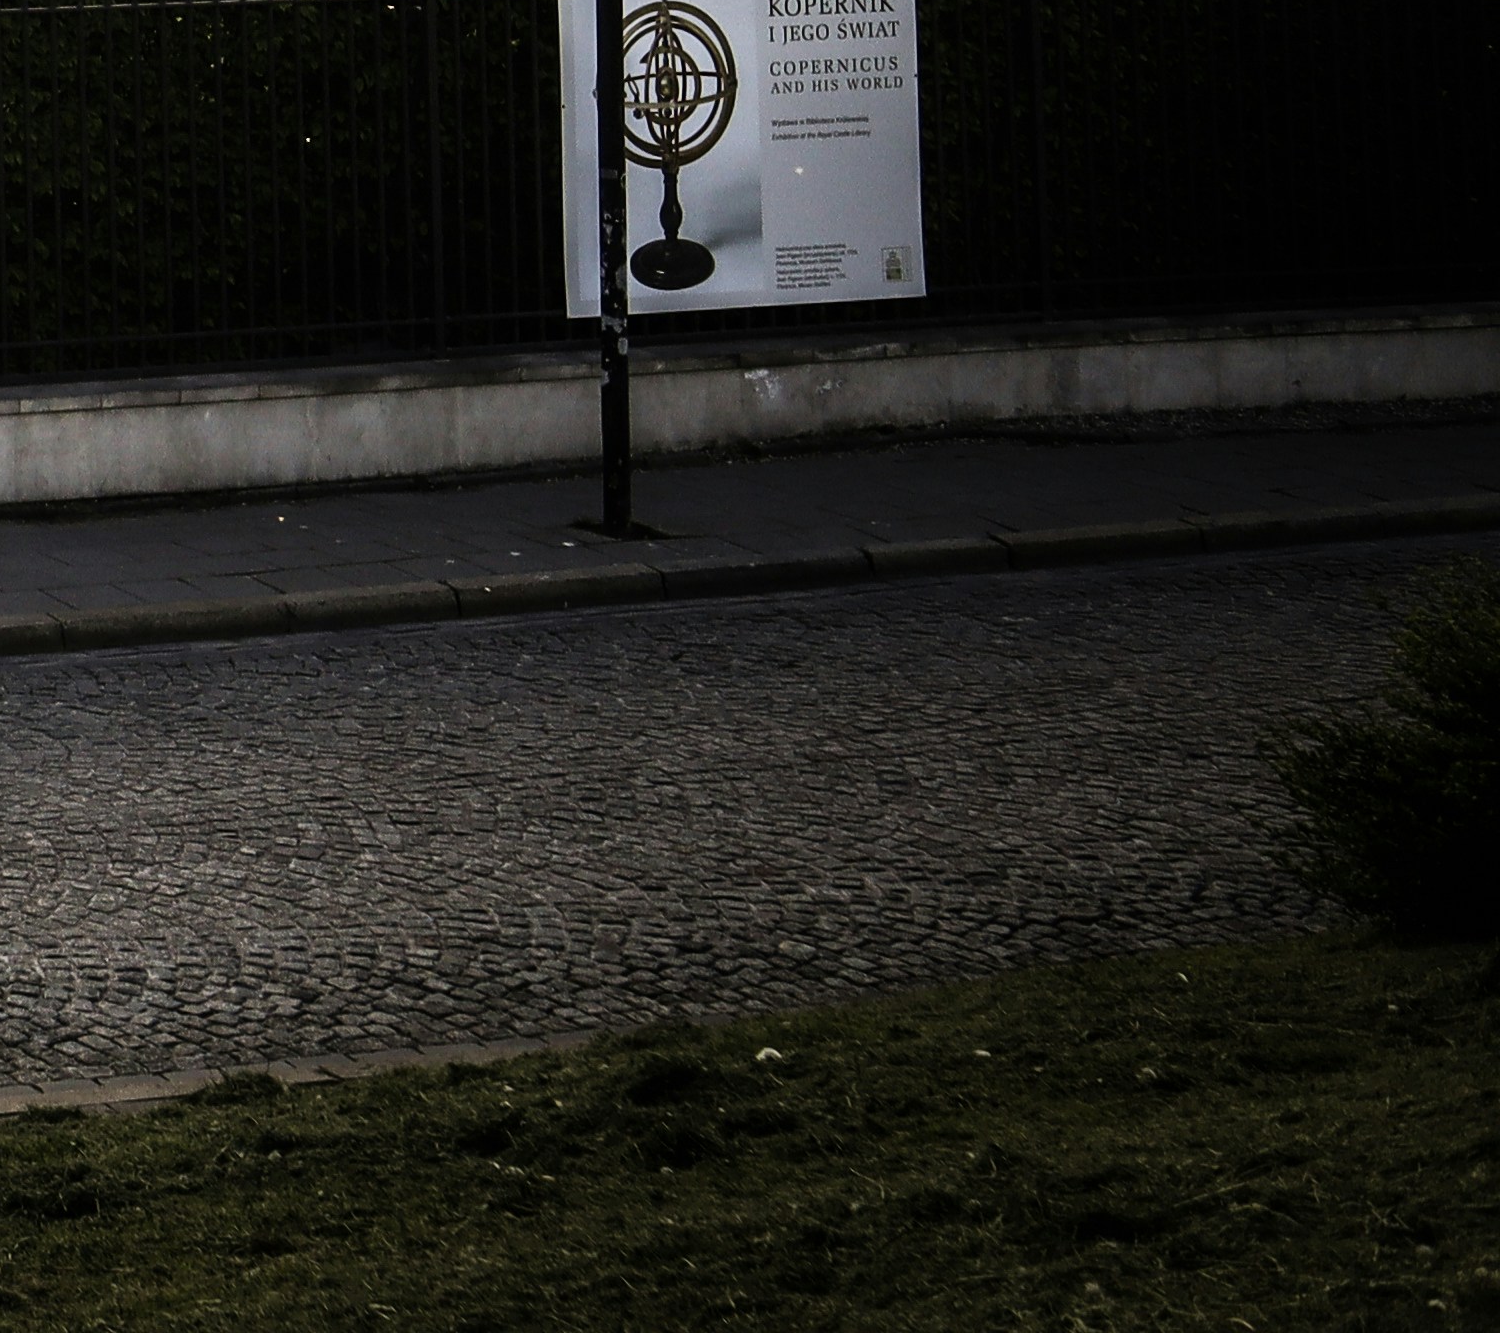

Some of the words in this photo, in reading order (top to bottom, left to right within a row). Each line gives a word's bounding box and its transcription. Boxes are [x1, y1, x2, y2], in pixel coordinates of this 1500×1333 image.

[769, 25, 775, 43] I
[782, 23, 830, 46] JEGO
[837, 18, 900, 40] ŚWIAT
[769, 56, 899, 77] COPERNICUS
[771, 81, 804, 95] AND
[812, 79, 839, 92] HIS
[847, 76, 904, 90] WORLD
